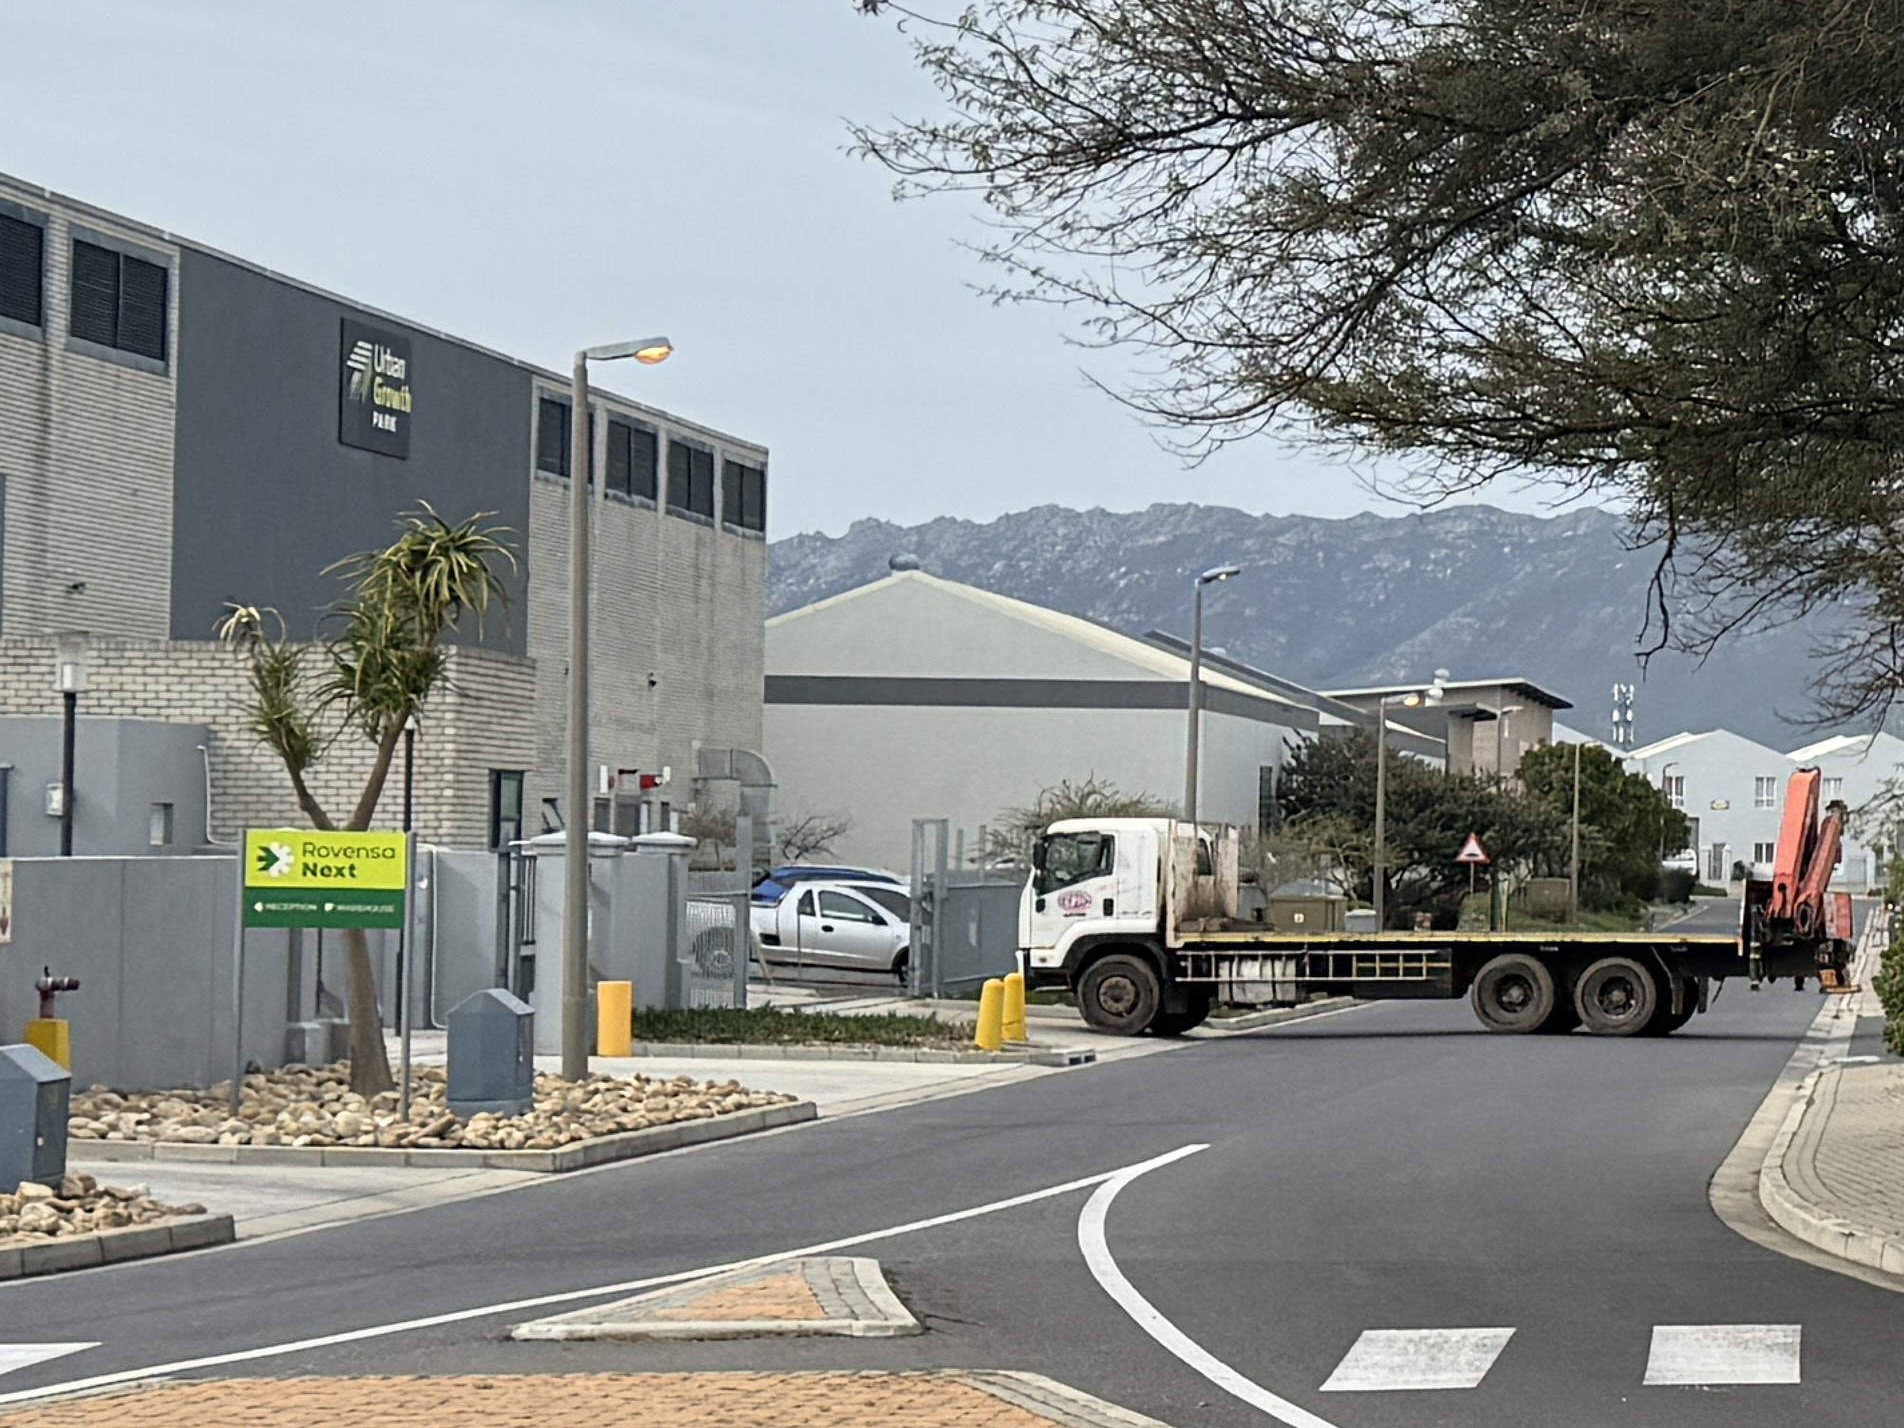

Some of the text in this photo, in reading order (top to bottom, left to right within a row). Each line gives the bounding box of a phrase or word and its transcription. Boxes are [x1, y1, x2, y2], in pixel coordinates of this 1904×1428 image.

[374, 344, 405, 380] Urban
[373, 376, 412, 413] Growth
[373, 411, 397, 432] PARK
[302, 842, 396, 859] Rovensa
[302, 862, 357, 878] Next
